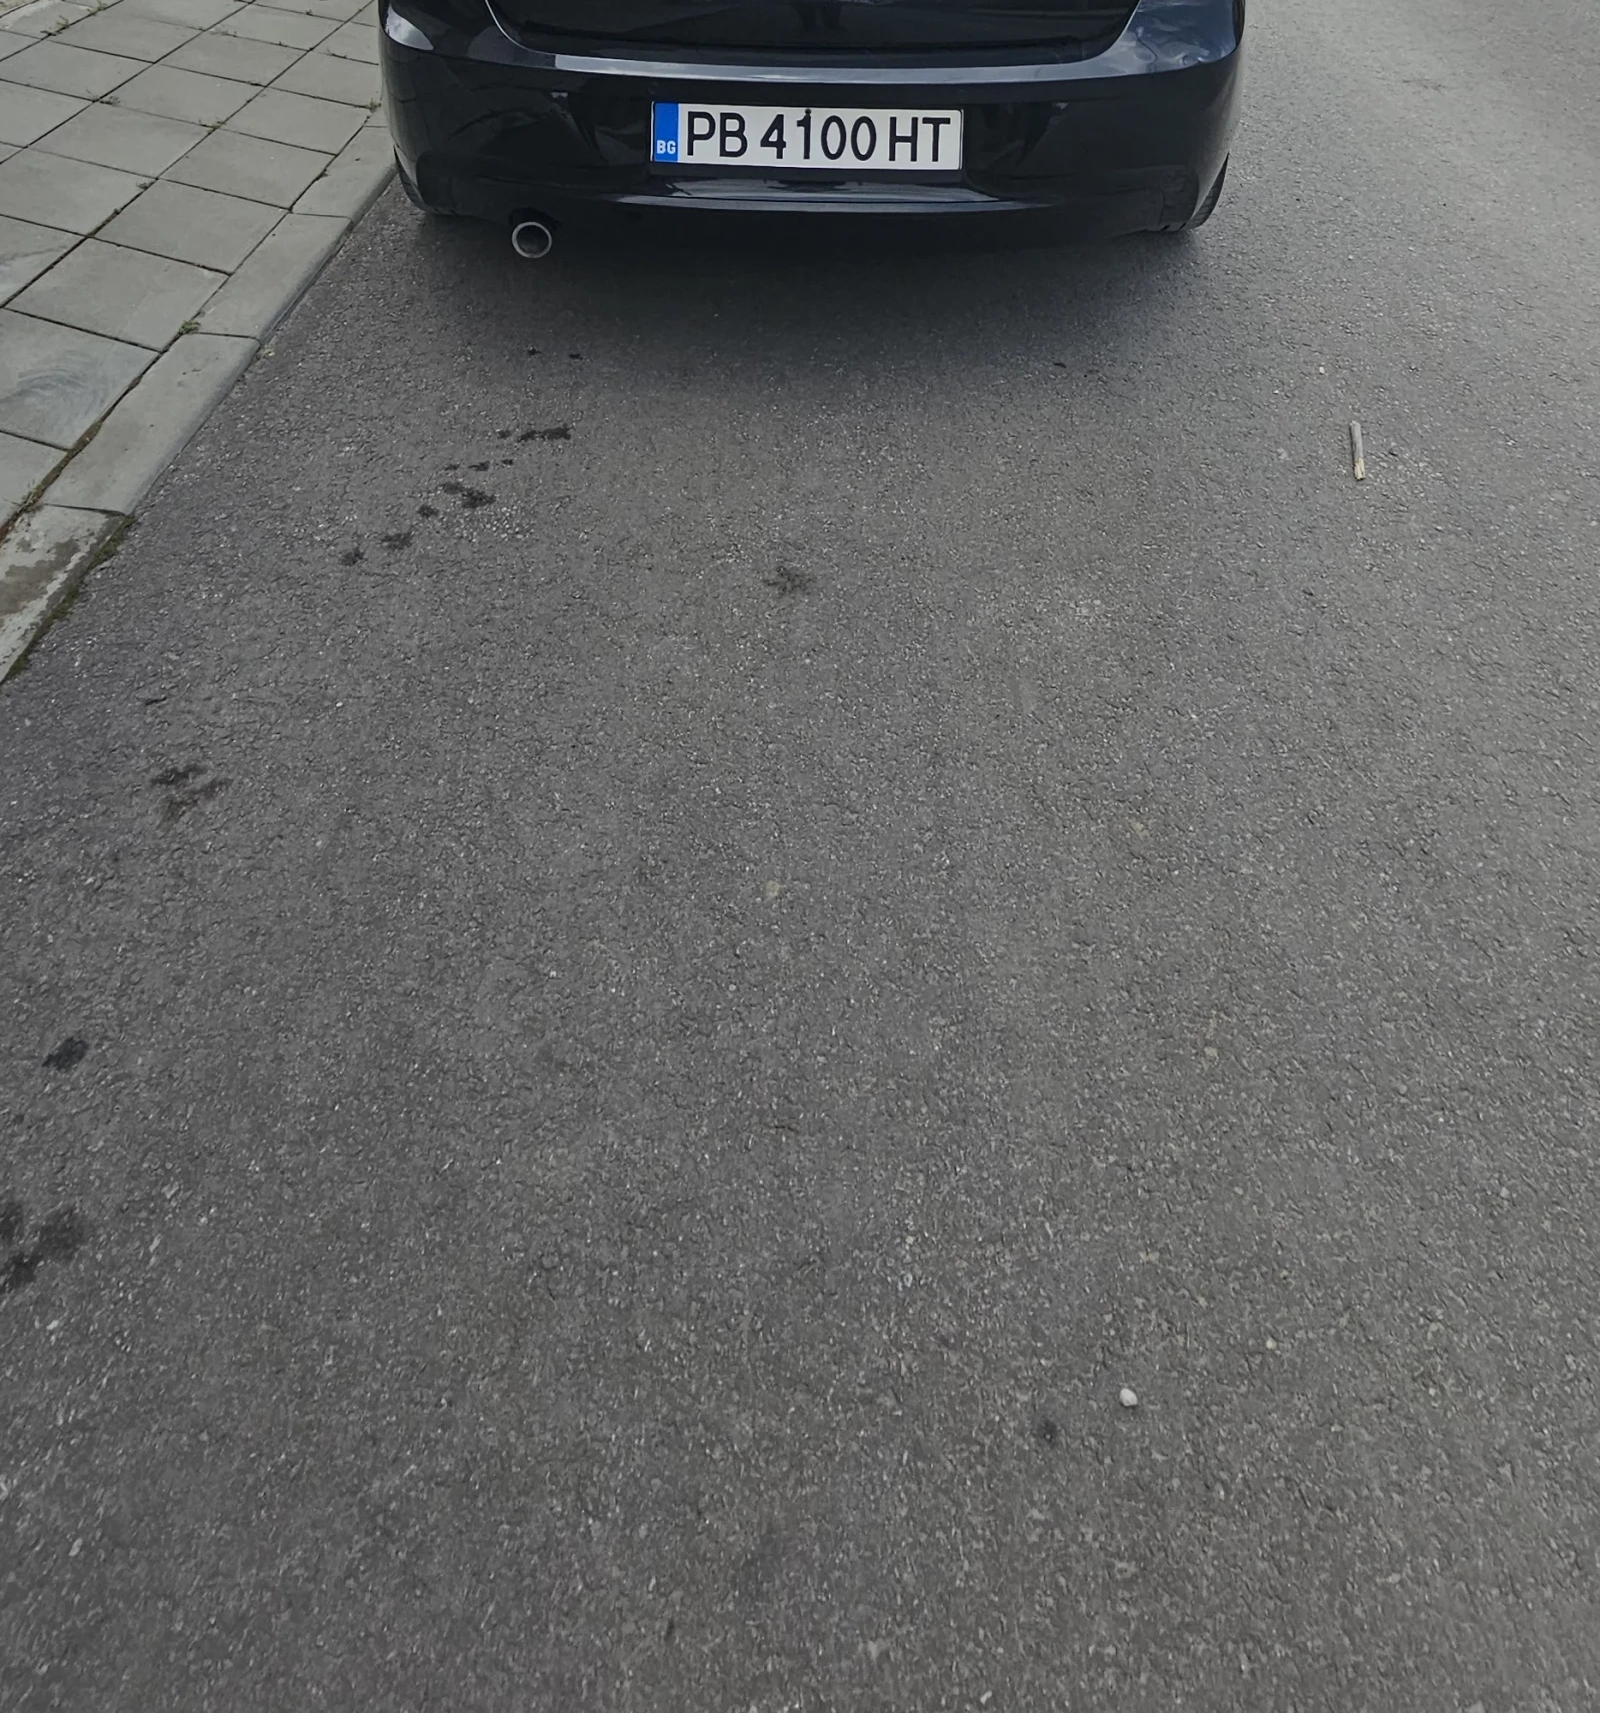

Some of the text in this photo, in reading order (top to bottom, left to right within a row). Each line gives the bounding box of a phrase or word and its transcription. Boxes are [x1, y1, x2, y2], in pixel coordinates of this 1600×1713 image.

[656, 139, 676, 154] BG
[687, 111, 951, 162] PB 4100 HT
